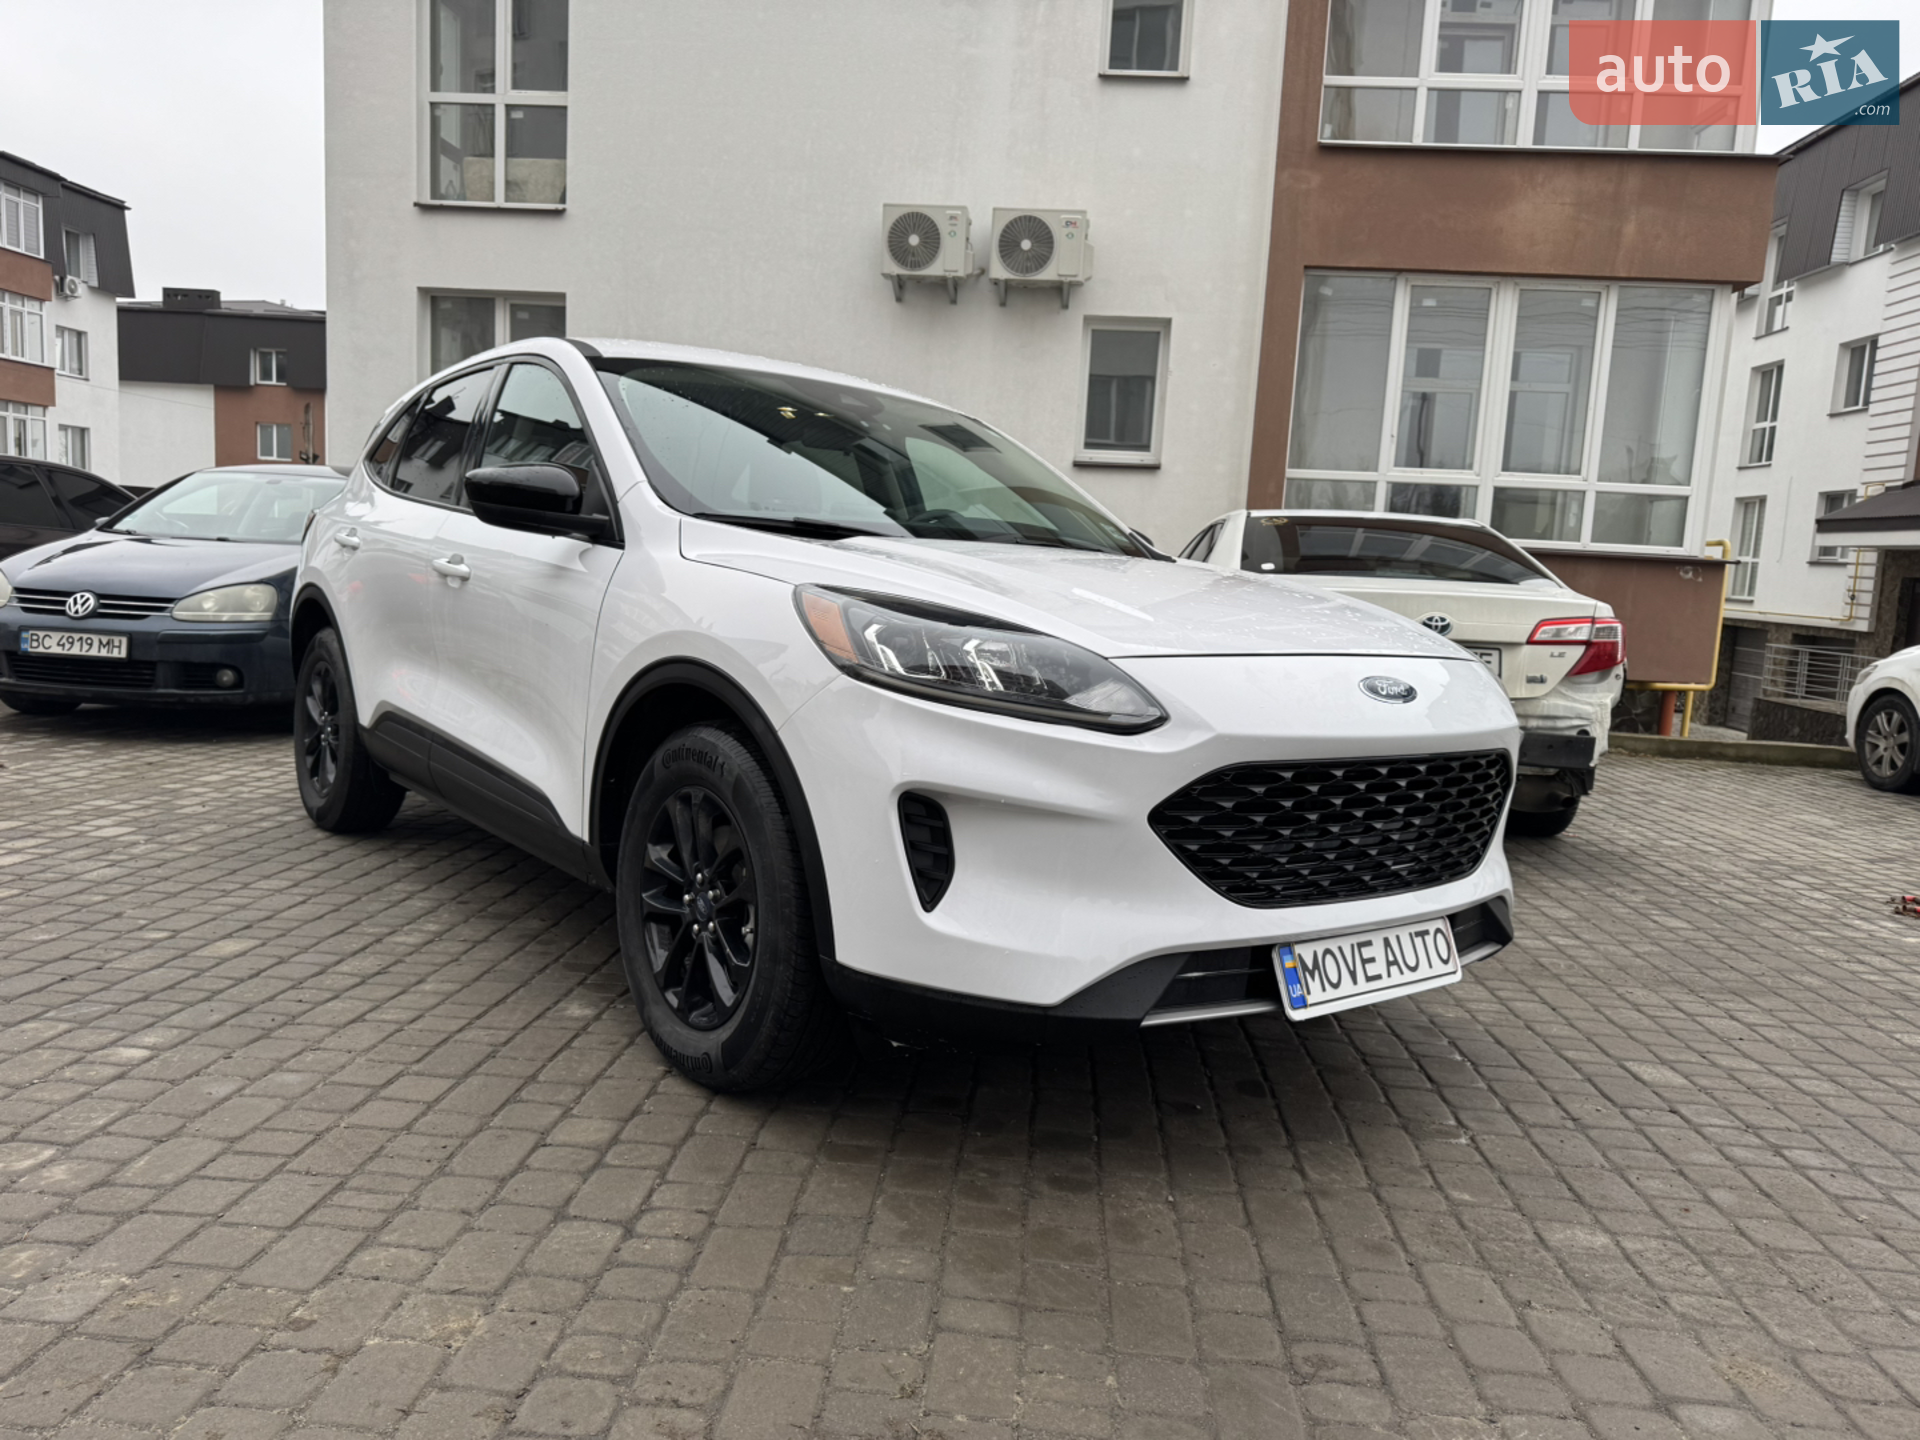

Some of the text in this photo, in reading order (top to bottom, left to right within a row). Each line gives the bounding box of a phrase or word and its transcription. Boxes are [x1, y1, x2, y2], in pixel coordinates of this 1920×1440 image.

[29, 632, 53, 650] BC
[56, 635, 94, 653] 4919
[97, 638, 122, 655] MH
[1375, 679, 1408, 696] Ford
[662, 743, 719, 772] Continental
[1289, 927, 1451, 998] UA MOVEAUTO
